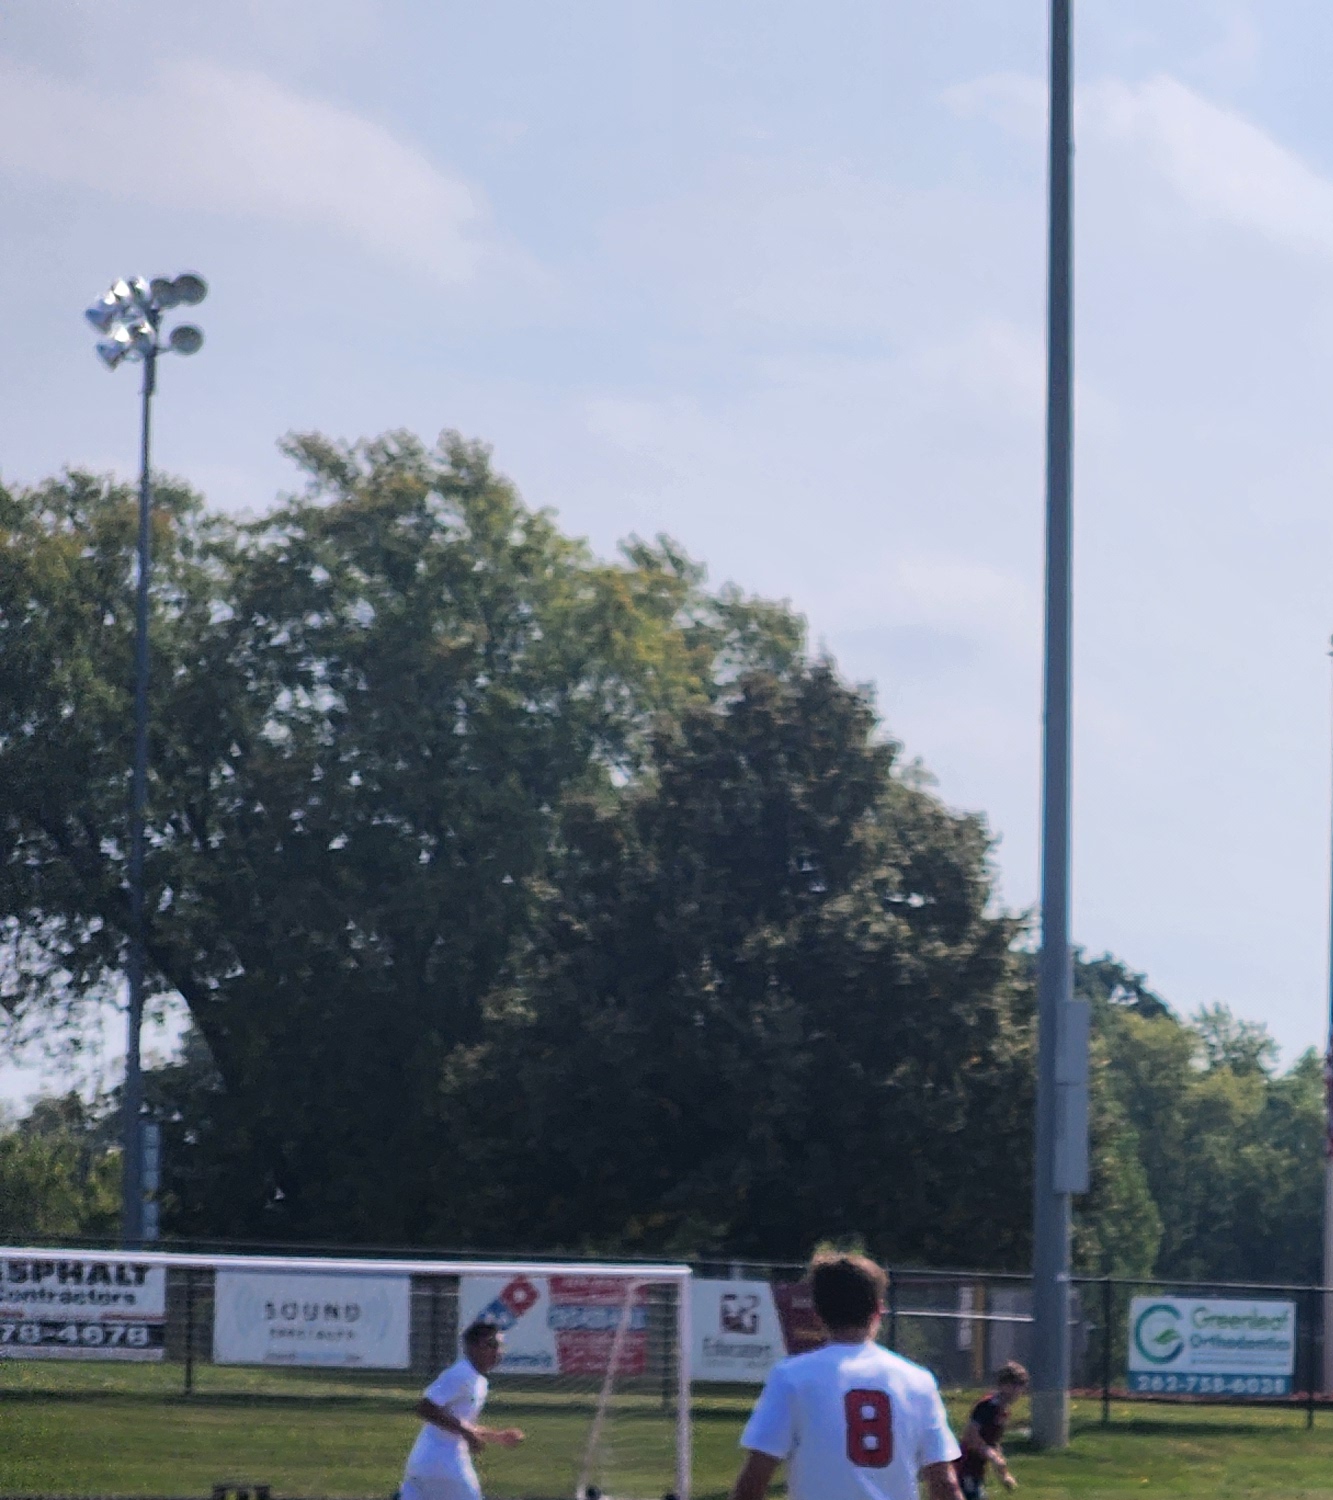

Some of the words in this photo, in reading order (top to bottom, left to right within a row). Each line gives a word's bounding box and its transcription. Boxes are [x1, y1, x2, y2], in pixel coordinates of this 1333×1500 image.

[0, 1260, 151, 1286] SPHALT
[0, 1288, 137, 1305] ontractors
[265, 1302, 361, 1322] SOUND
[843, 1389, 894, 1468] 8
